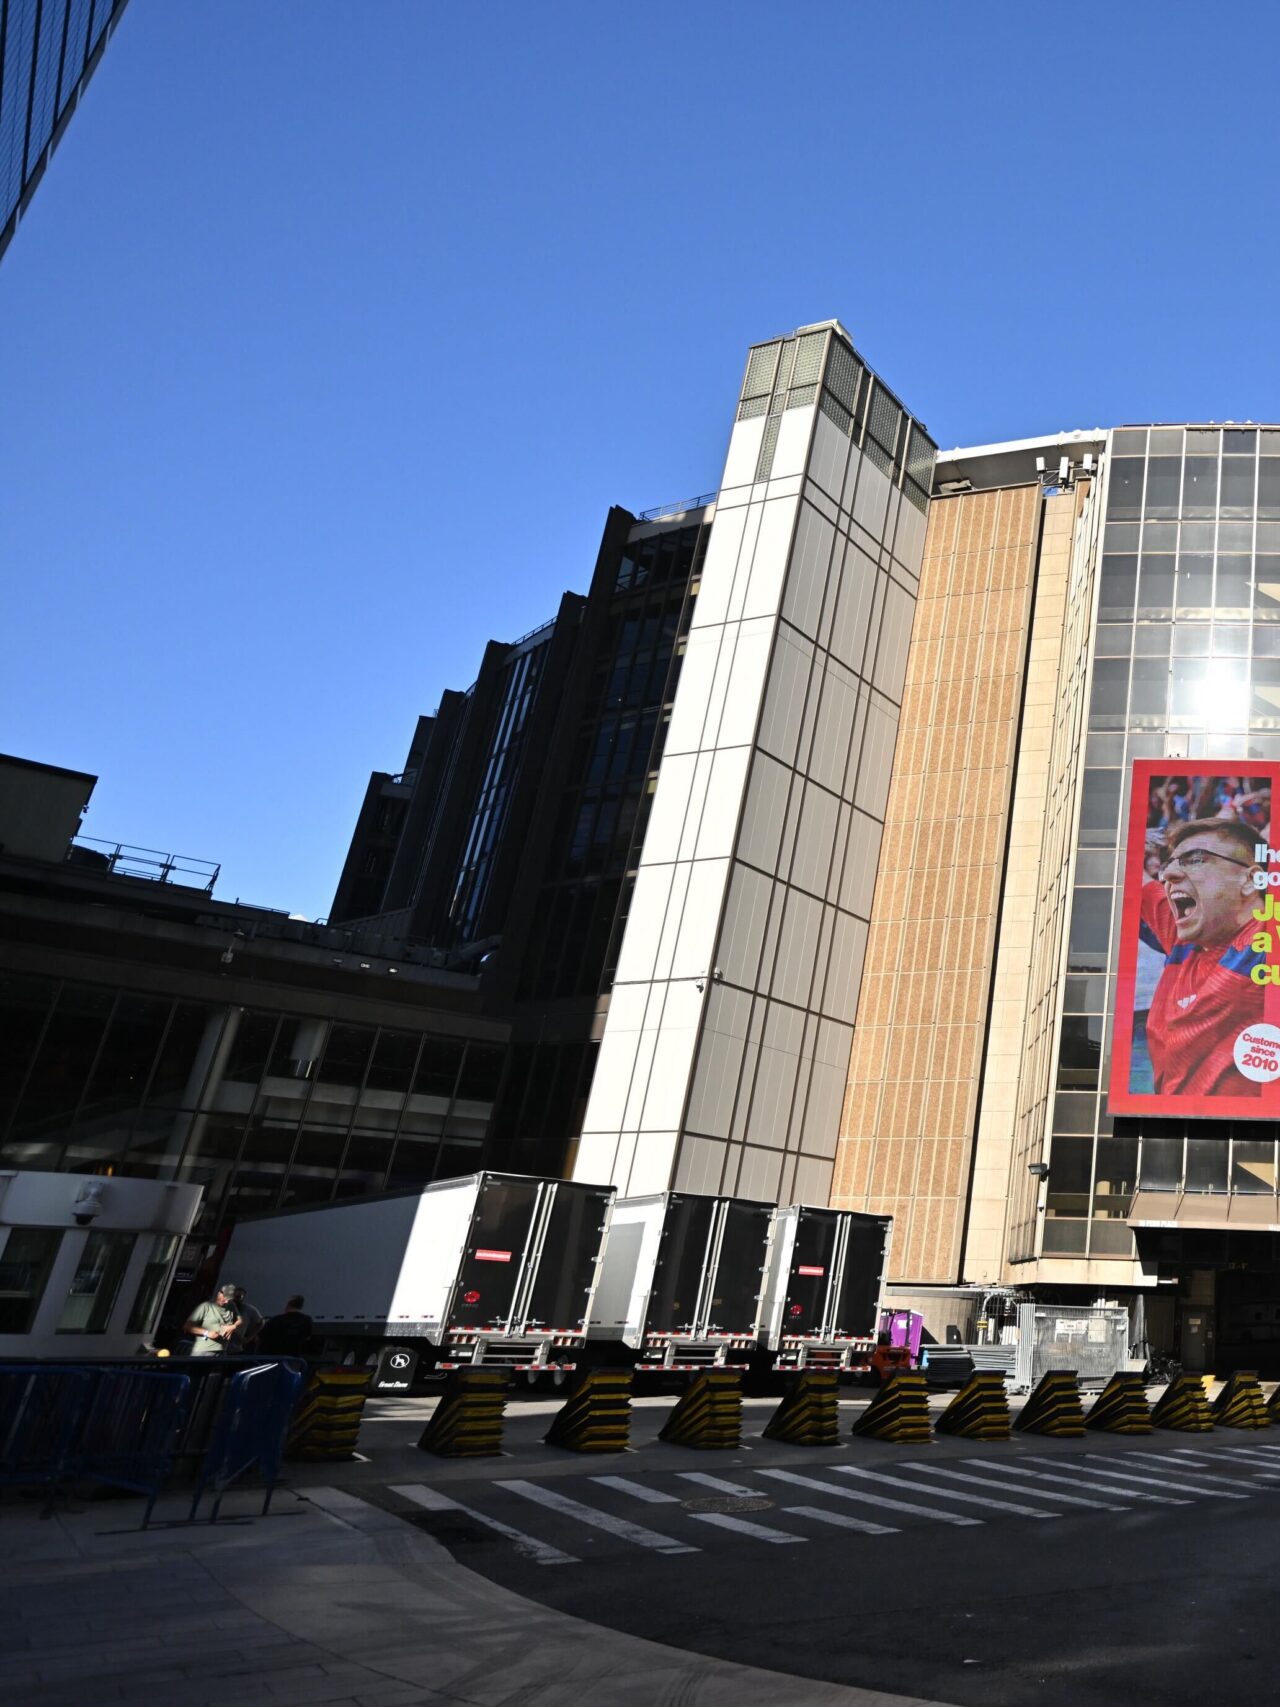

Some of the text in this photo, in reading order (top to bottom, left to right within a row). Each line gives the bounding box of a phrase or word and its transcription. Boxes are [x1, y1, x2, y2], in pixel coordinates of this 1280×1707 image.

[1251, 931, 1272, 953] a
[1250, 1045, 1276, 1057] since
[1241, 1053, 1279, 1072] 2010
